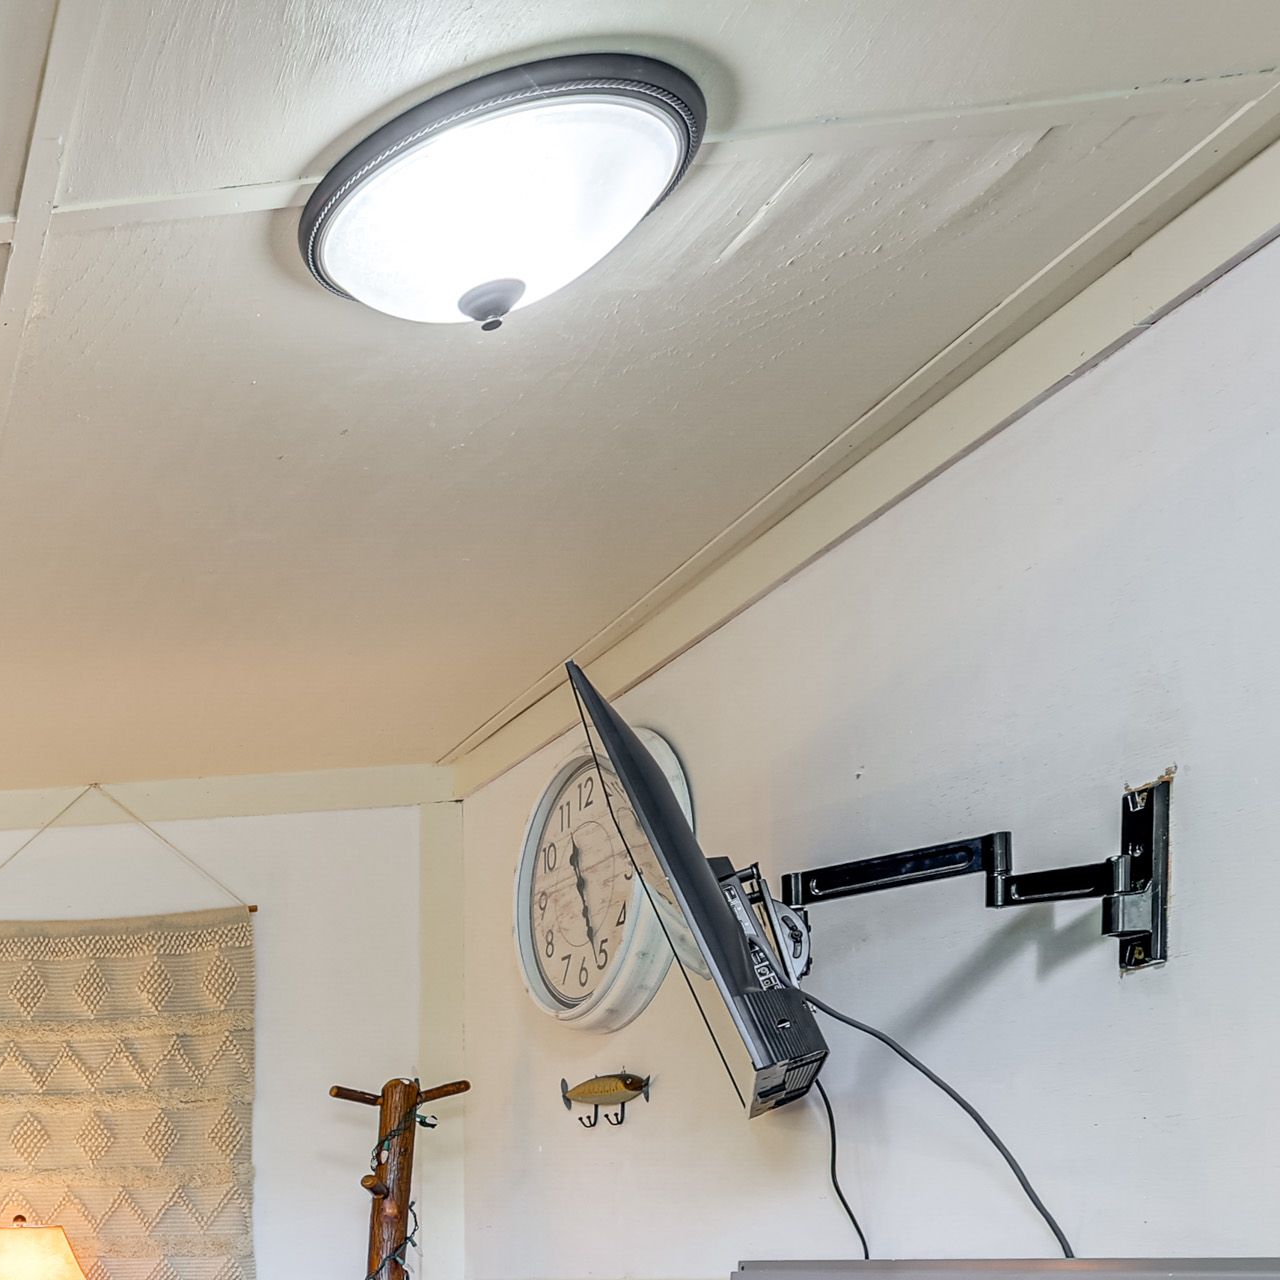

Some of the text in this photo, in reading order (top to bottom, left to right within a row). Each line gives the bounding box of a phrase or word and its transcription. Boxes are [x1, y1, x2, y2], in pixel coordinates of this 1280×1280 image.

[577, 776, 594, 811] 12
[559, 801, 571, 832] 11
[542, 842, 557, 874] 10
[539, 891, 548, 920] 9
[615, 901, 627, 927] 4
[545, 929, 554, 958] 8
[596, 938, 608, 970] 5
[561, 954, 572, 985] 7
[578, 956, 589, 987] 6
